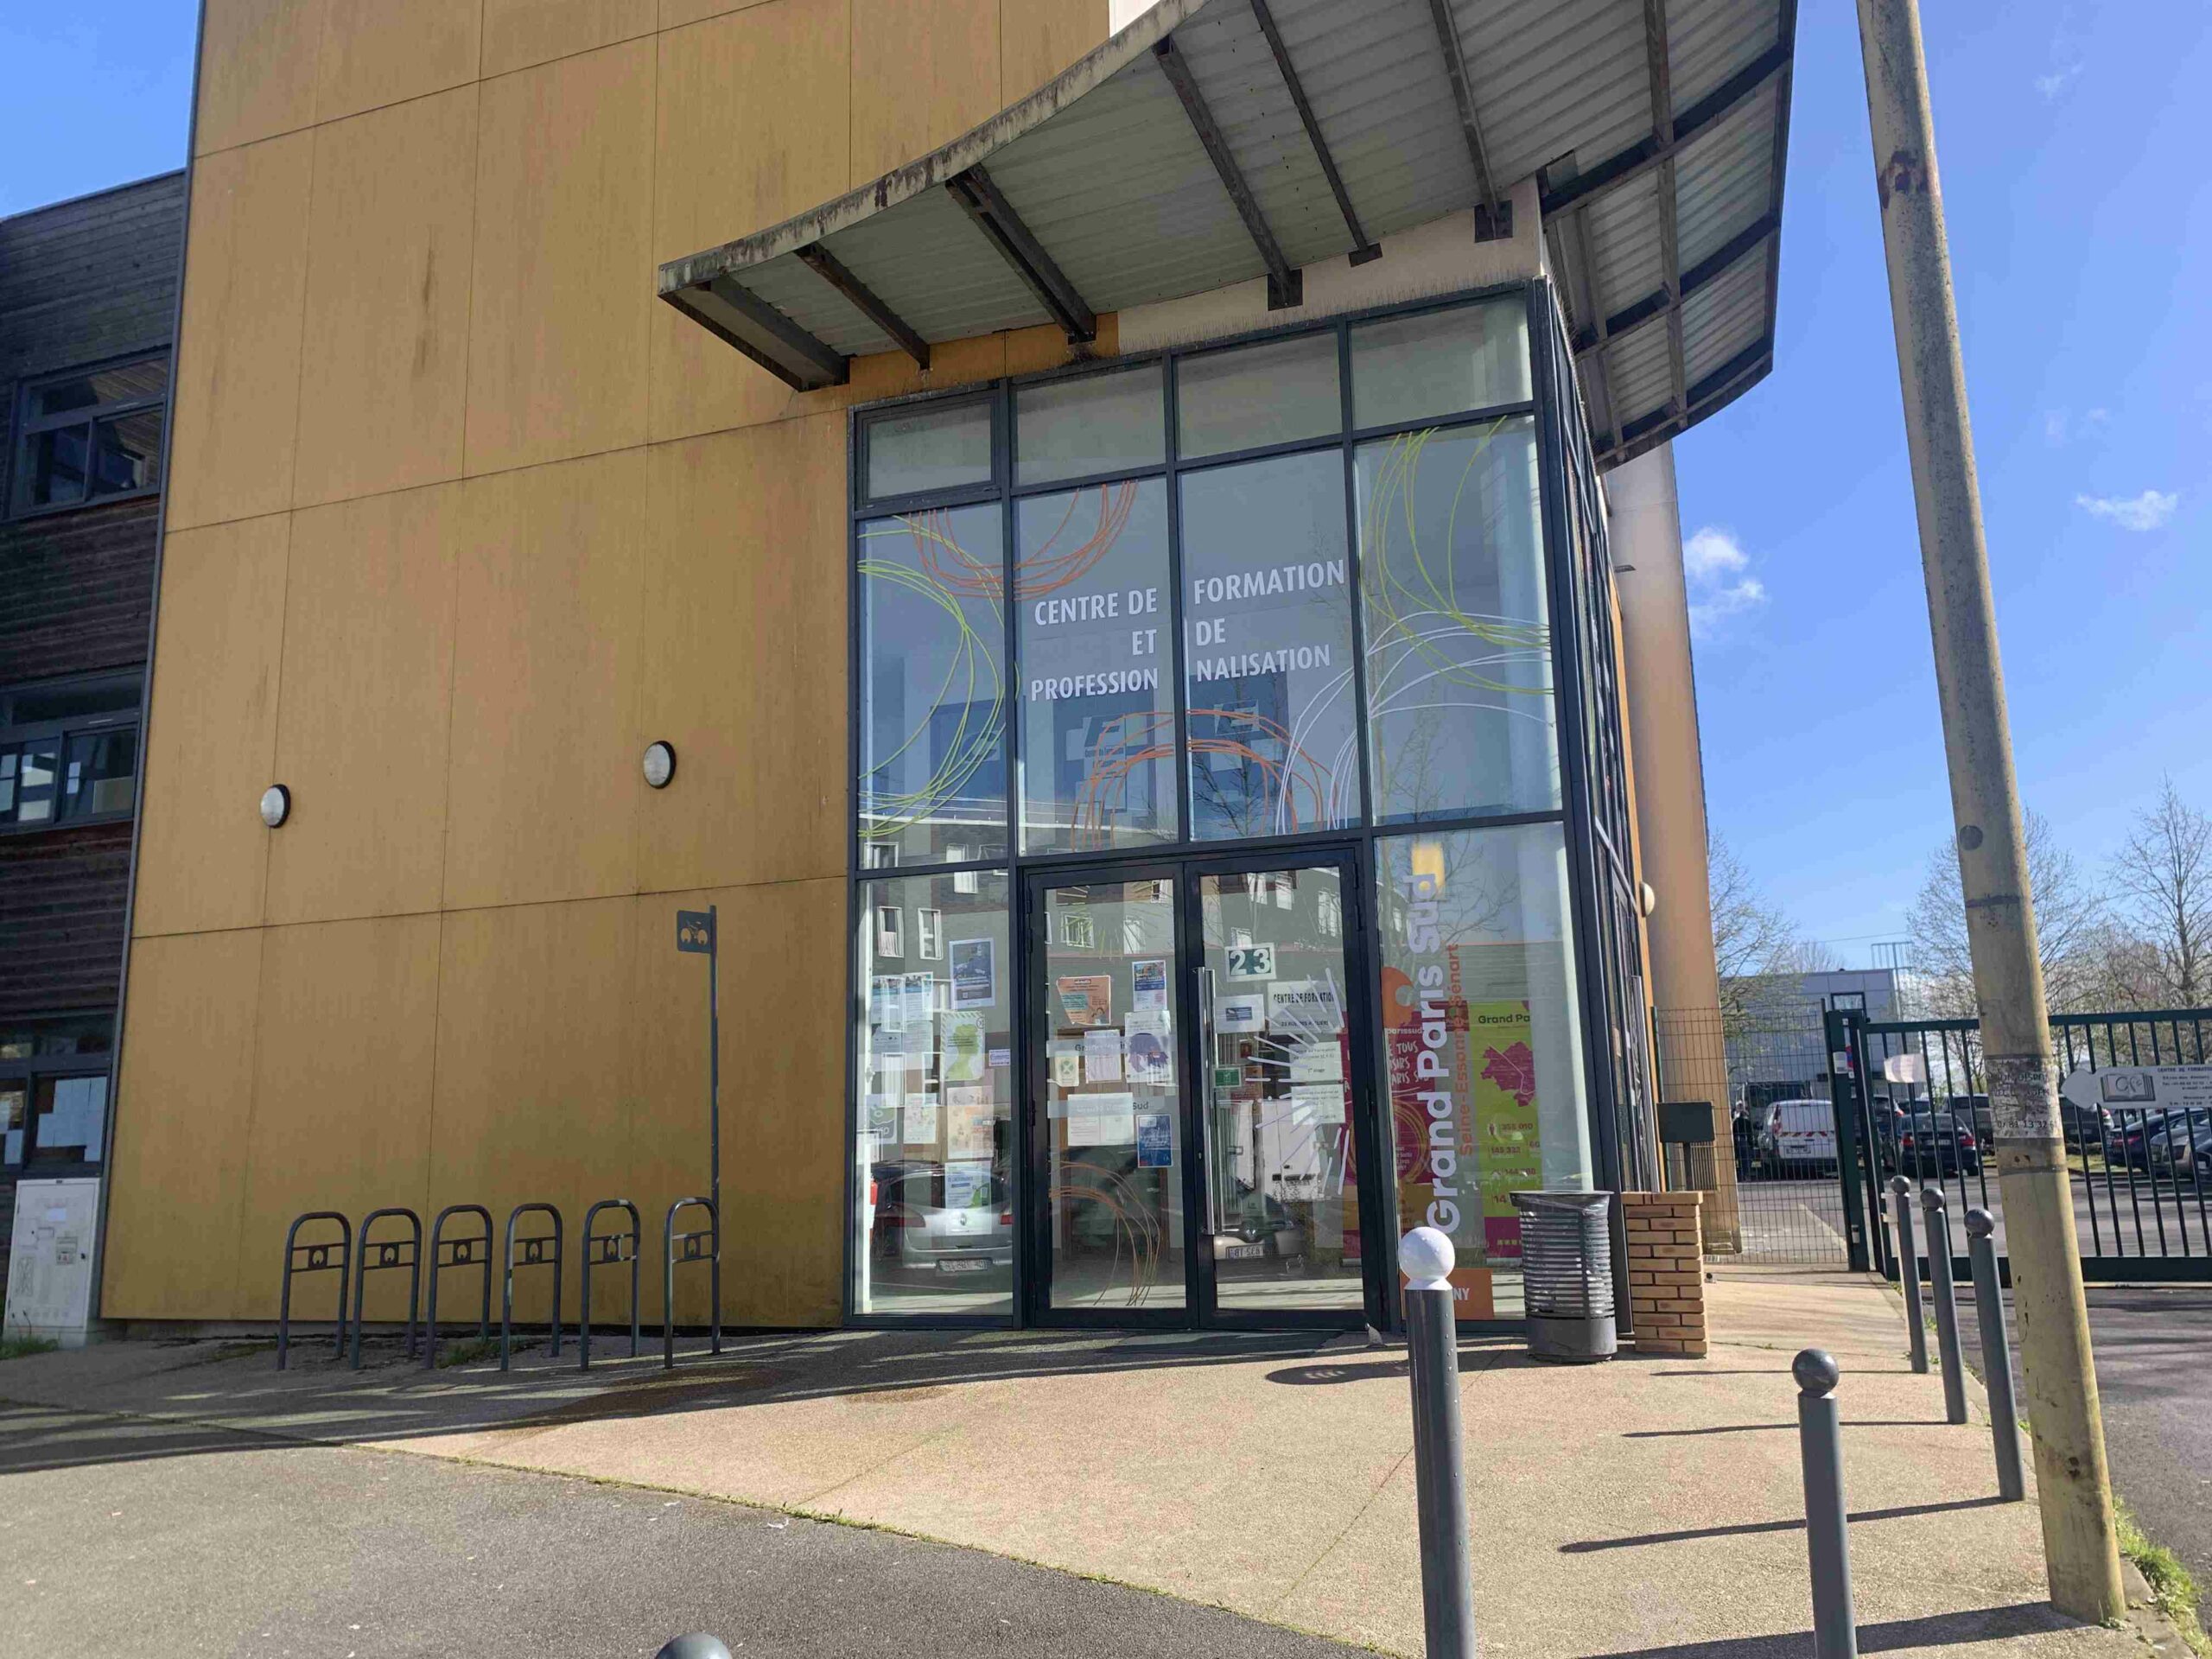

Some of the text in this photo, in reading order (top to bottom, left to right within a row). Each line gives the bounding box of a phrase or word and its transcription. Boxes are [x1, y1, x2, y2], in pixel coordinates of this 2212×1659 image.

[1035, 559, 1344, 626] CENTRE DE FORMATION
[1132, 618, 1225, 655] ET DE
[1031, 645, 1331, 701] PROFESSION NALISATION
[1230, 948, 1271, 975] 23
[1305, 992, 1334, 1002] FORATION
[1478, 1014, 1513, 1024] Grand
[1396, 1040, 1418, 1054] TOUS
[1402, 874, 1460, 1234] Grand Paris Sud
